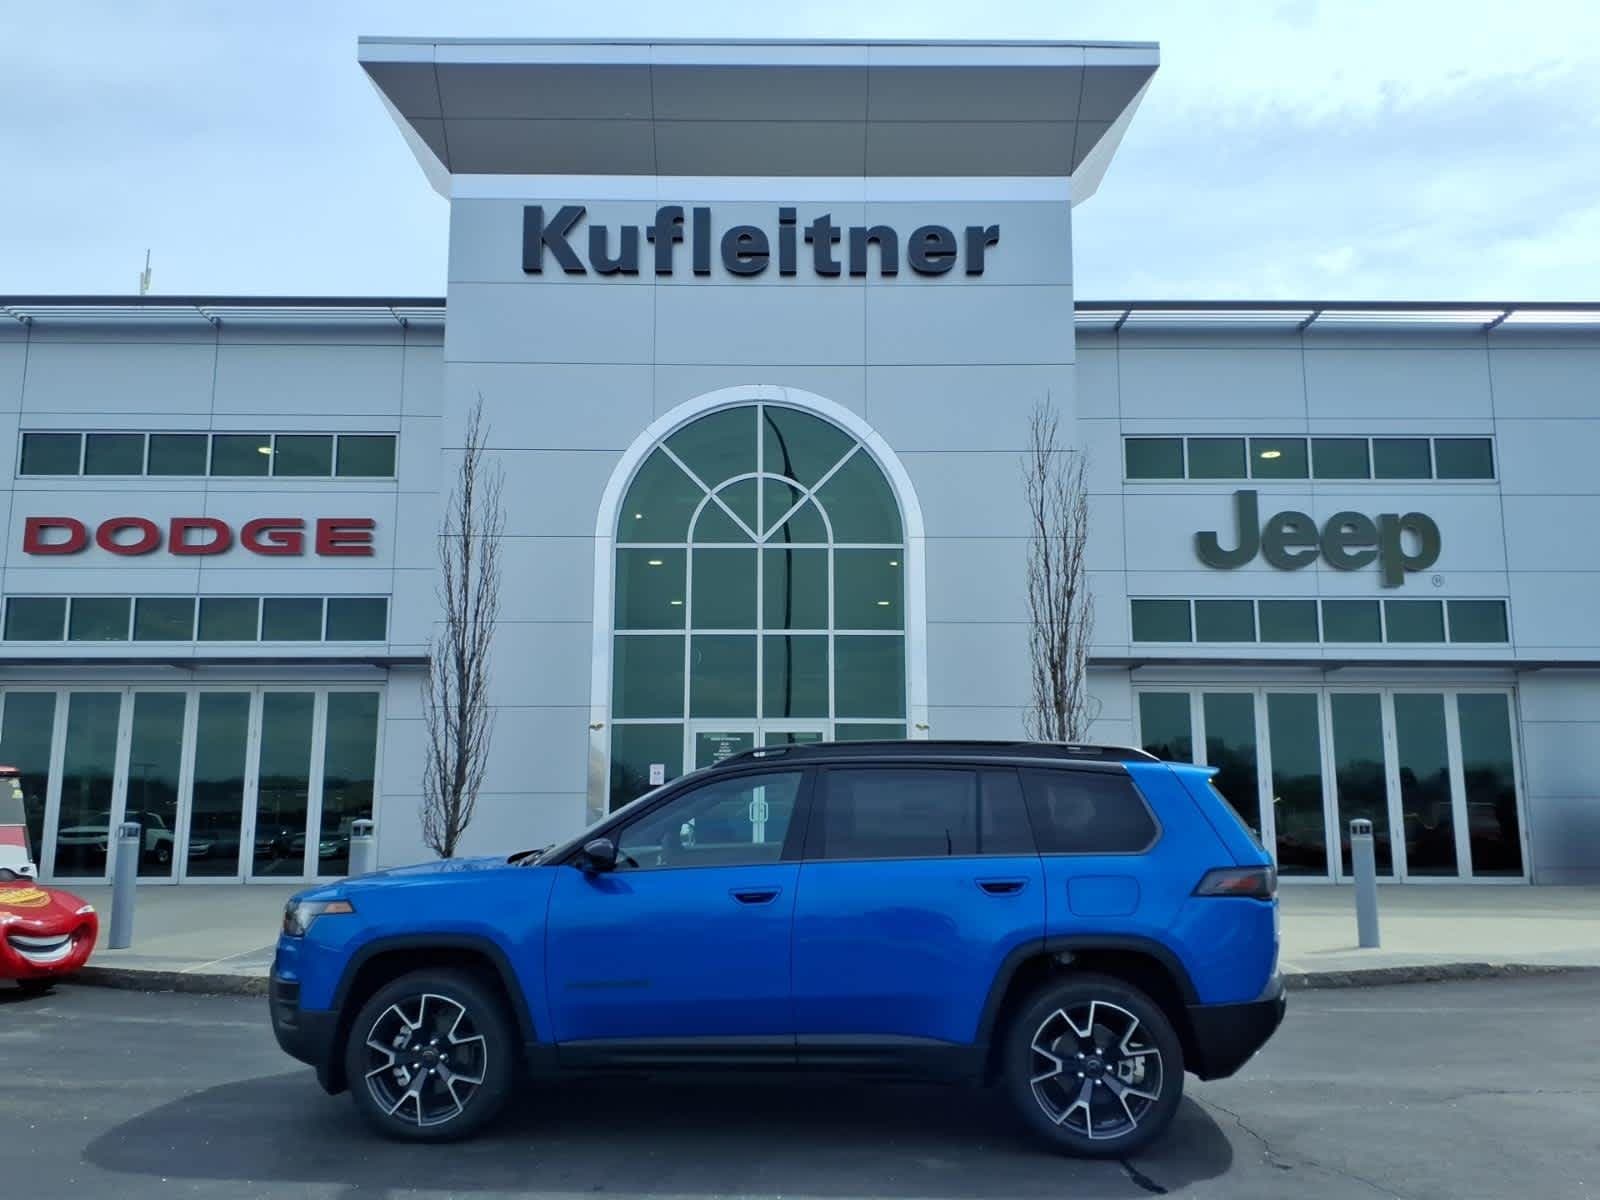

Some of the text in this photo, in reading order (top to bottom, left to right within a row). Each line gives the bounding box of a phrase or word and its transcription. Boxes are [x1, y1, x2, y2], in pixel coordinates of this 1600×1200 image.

[521, 205, 1000, 277] Kufleitner
[23, 517, 376, 556] DODGE
[1195, 490, 1441, 588] Jeep
